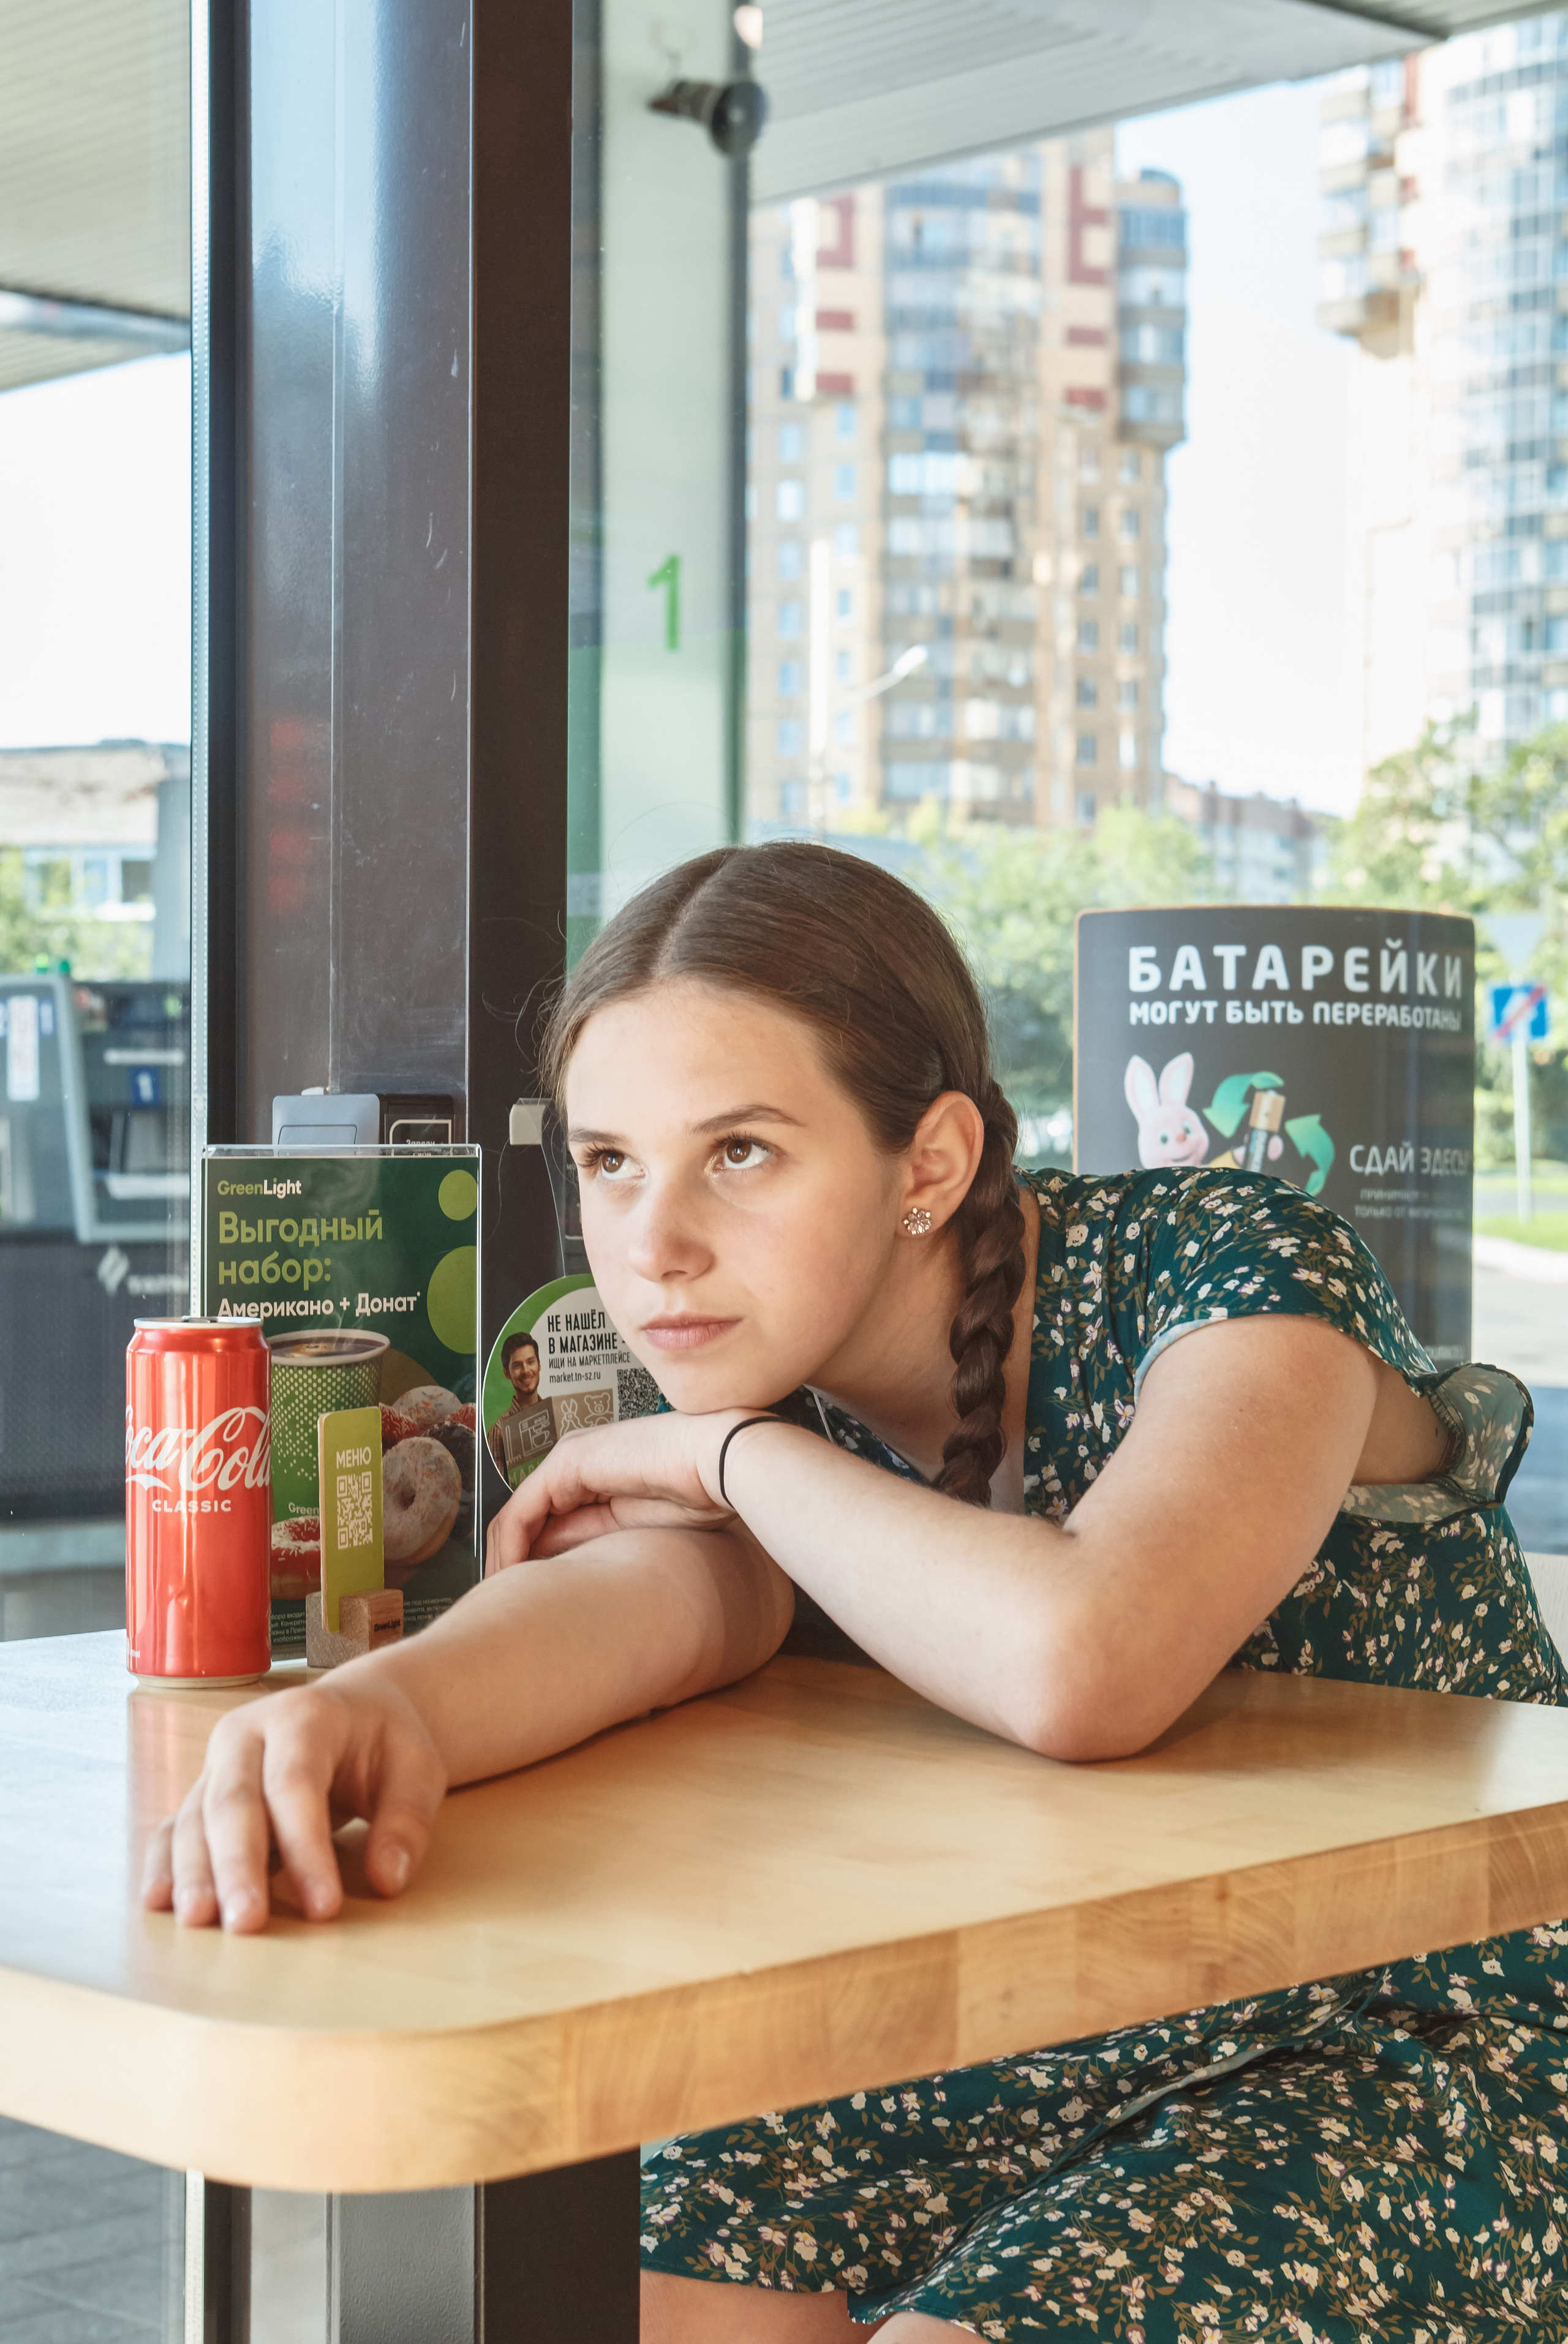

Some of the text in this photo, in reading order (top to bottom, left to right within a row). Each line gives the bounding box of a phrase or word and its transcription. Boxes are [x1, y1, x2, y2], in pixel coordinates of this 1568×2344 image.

[647, 554, 679, 652] 1
[1129, 937, 1462, 1000] БАТАРЕЙКИ
[1129, 1000, 1461, 1032] МОГУТ БЫТЬ ПЕРЕРАБОТАНЫ
[1349, 1140, 1415, 1176] СДАЙ
[217, 1177, 301, 1199] GreenLight
[219, 1209, 383, 1248] Выгодный
[218, 1250, 331, 1291] набор:
[217, 1298, 334, 1317] Американо
[339, 1297, 350, 1311] +
[548, 1309, 606, 1333] НЕ НАШЁЛ
[548, 1336, 556, 1355] В
[559, 1332, 618, 1354] МАГАЗИНЕ
[549, 1351, 631, 1369] ИЩИ НА МАРКЕТПЛЕЙСЕ
[549, 1371, 601, 1384] market.tn-sz.ru
[336, 1446, 372, 1470] МЕНЮ
[152, 1499, 232, 1513] CLASSIC
